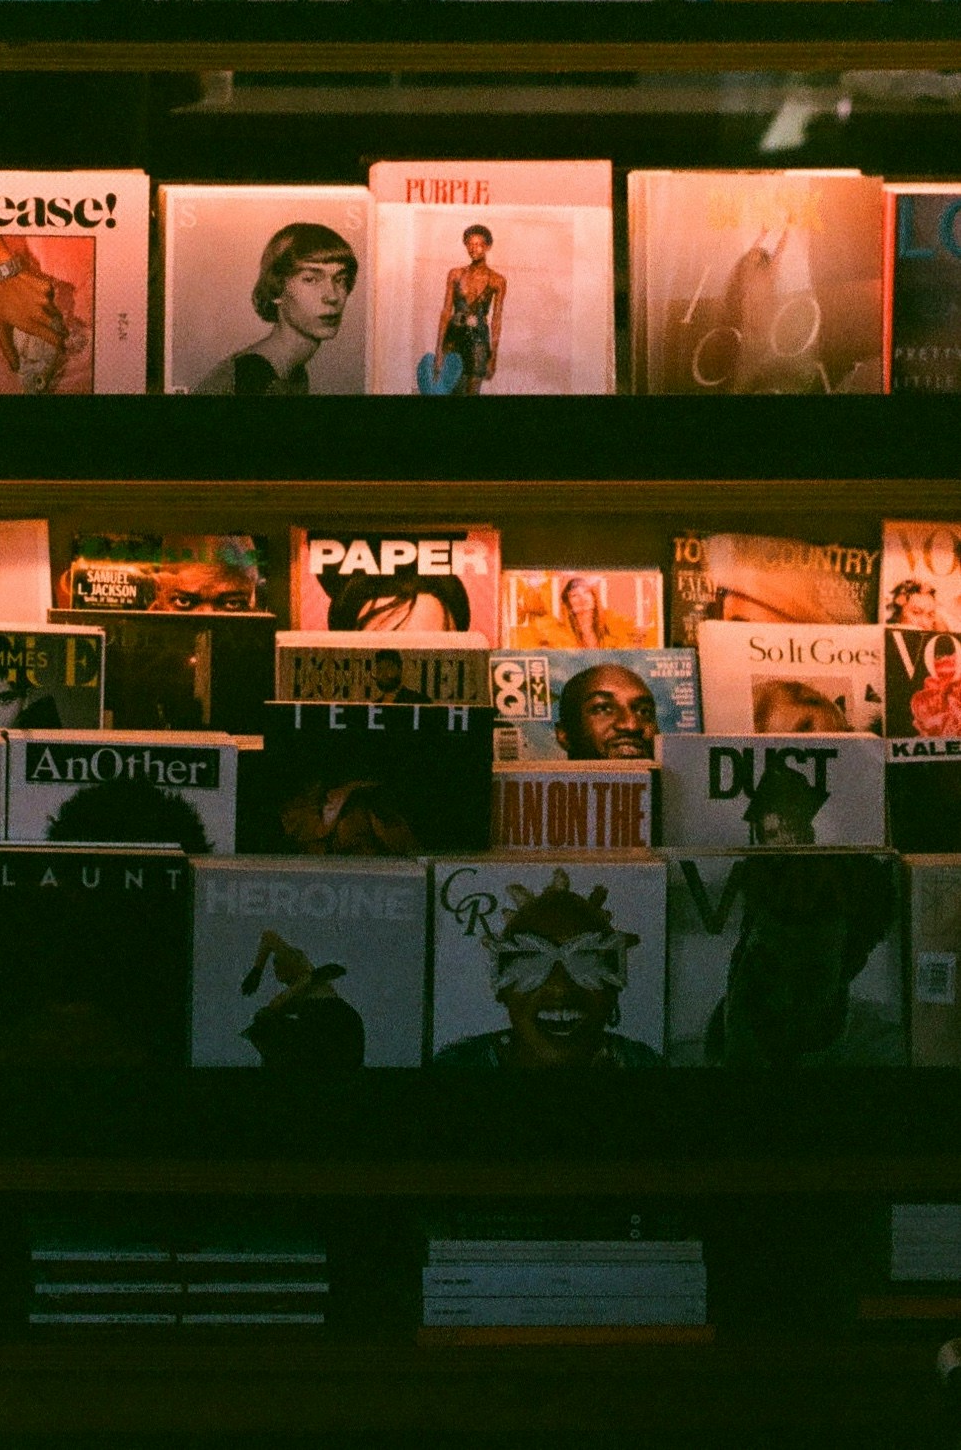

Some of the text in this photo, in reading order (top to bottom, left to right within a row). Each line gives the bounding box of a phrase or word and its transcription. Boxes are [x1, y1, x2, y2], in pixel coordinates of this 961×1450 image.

[406, 178, 490, 205] PURPLE
[309, 539, 488, 576] PAPER
[78, 583, 137, 598] L. JACKSON
[86, 570, 129, 584] SAMUEL
[749, 636, 881, 666] So It Goes
[494, 662, 526, 718] GQ
[530, 660, 545, 716] STYLE
[892, 740, 961, 758] KALE
[31, 747, 208, 785] AnOther
[207, 881, 416, 920] HEROINE
